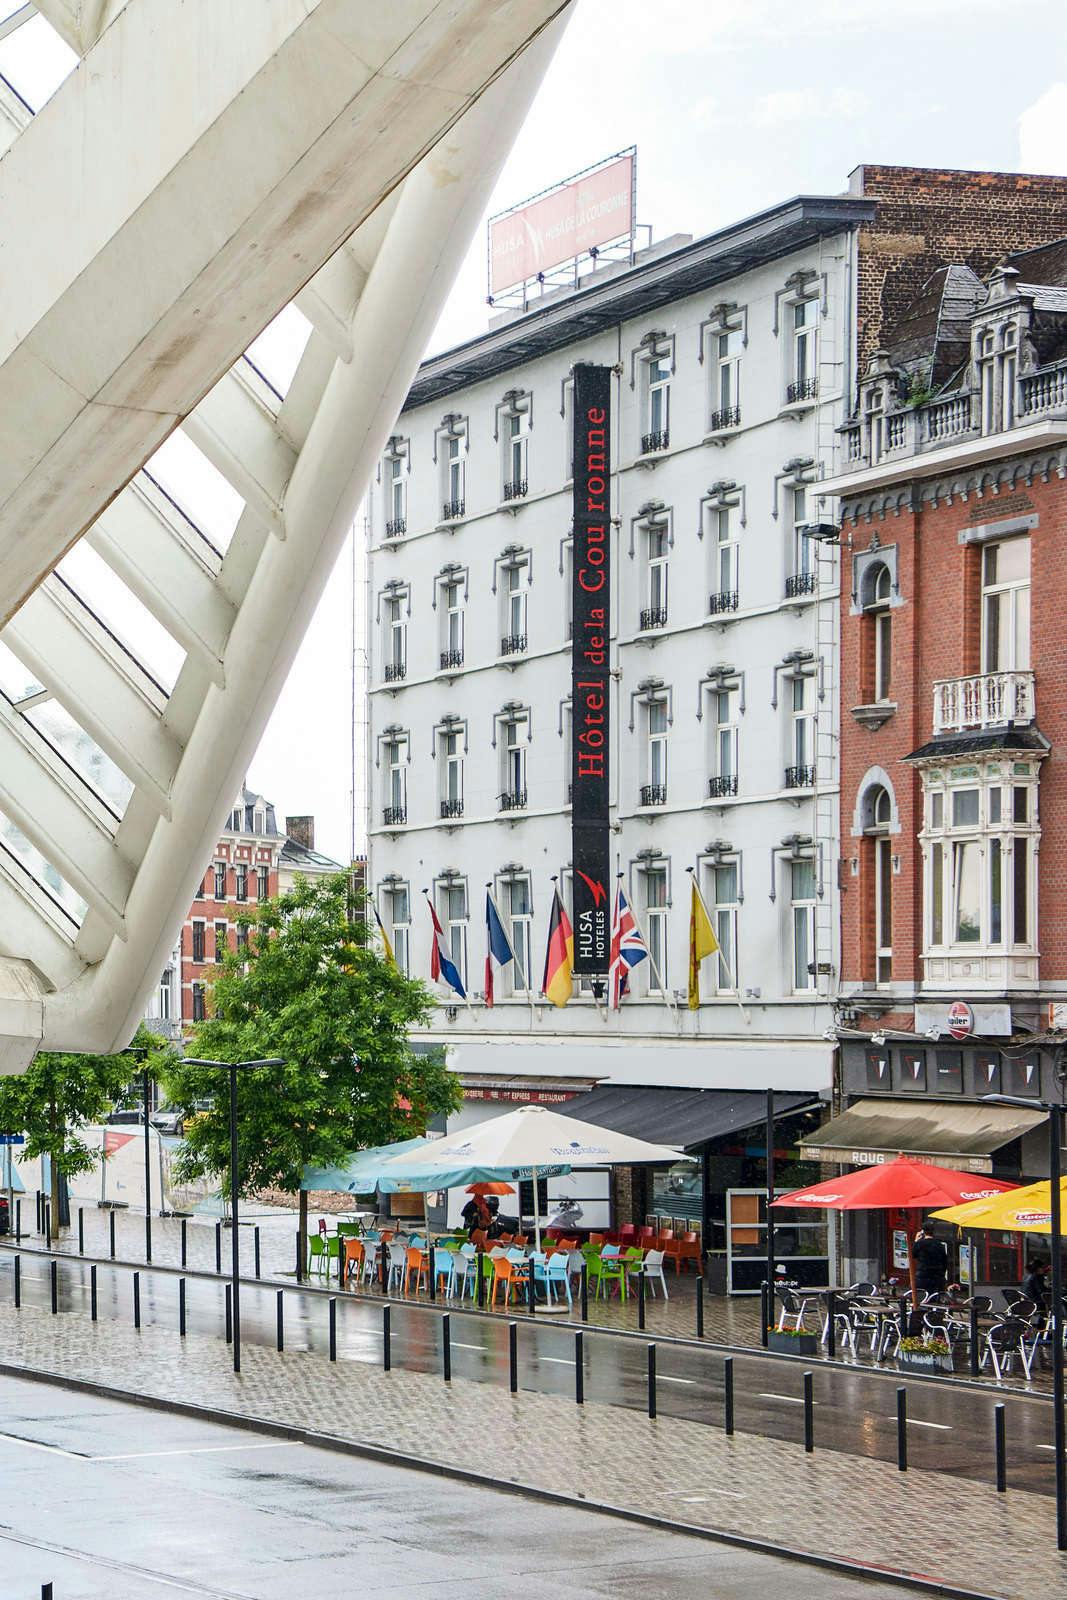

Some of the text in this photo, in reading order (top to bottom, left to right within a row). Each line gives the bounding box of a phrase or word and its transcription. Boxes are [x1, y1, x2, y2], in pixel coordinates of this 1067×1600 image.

[578, 407, 606, 778] Hôtel de la Couronne
[580, 910, 593, 958] HUSA
[596, 911, 605, 958] HOTELES
